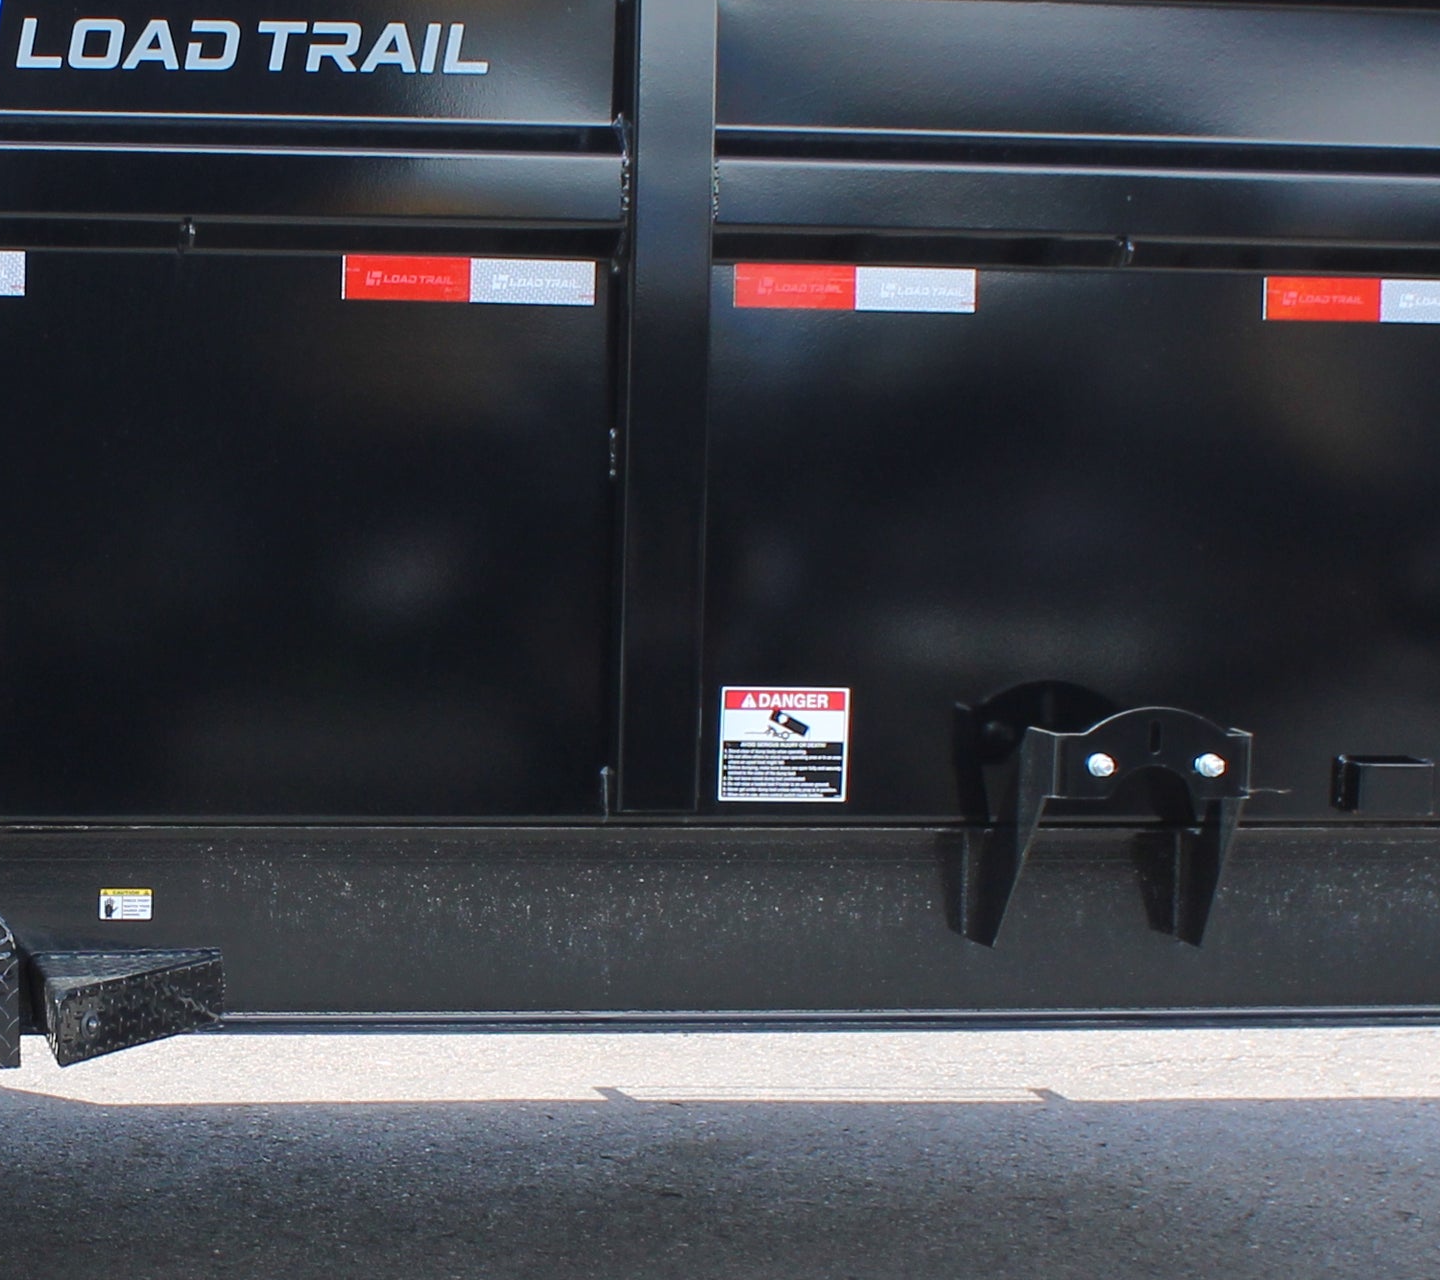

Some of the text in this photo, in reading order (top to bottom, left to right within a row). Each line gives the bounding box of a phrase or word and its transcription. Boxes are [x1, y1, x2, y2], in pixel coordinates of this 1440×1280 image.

[15, 18, 241, 71] LOAD
[257, 21, 489, 75] TRAIL
[758, 693, 829, 708] DANGER
